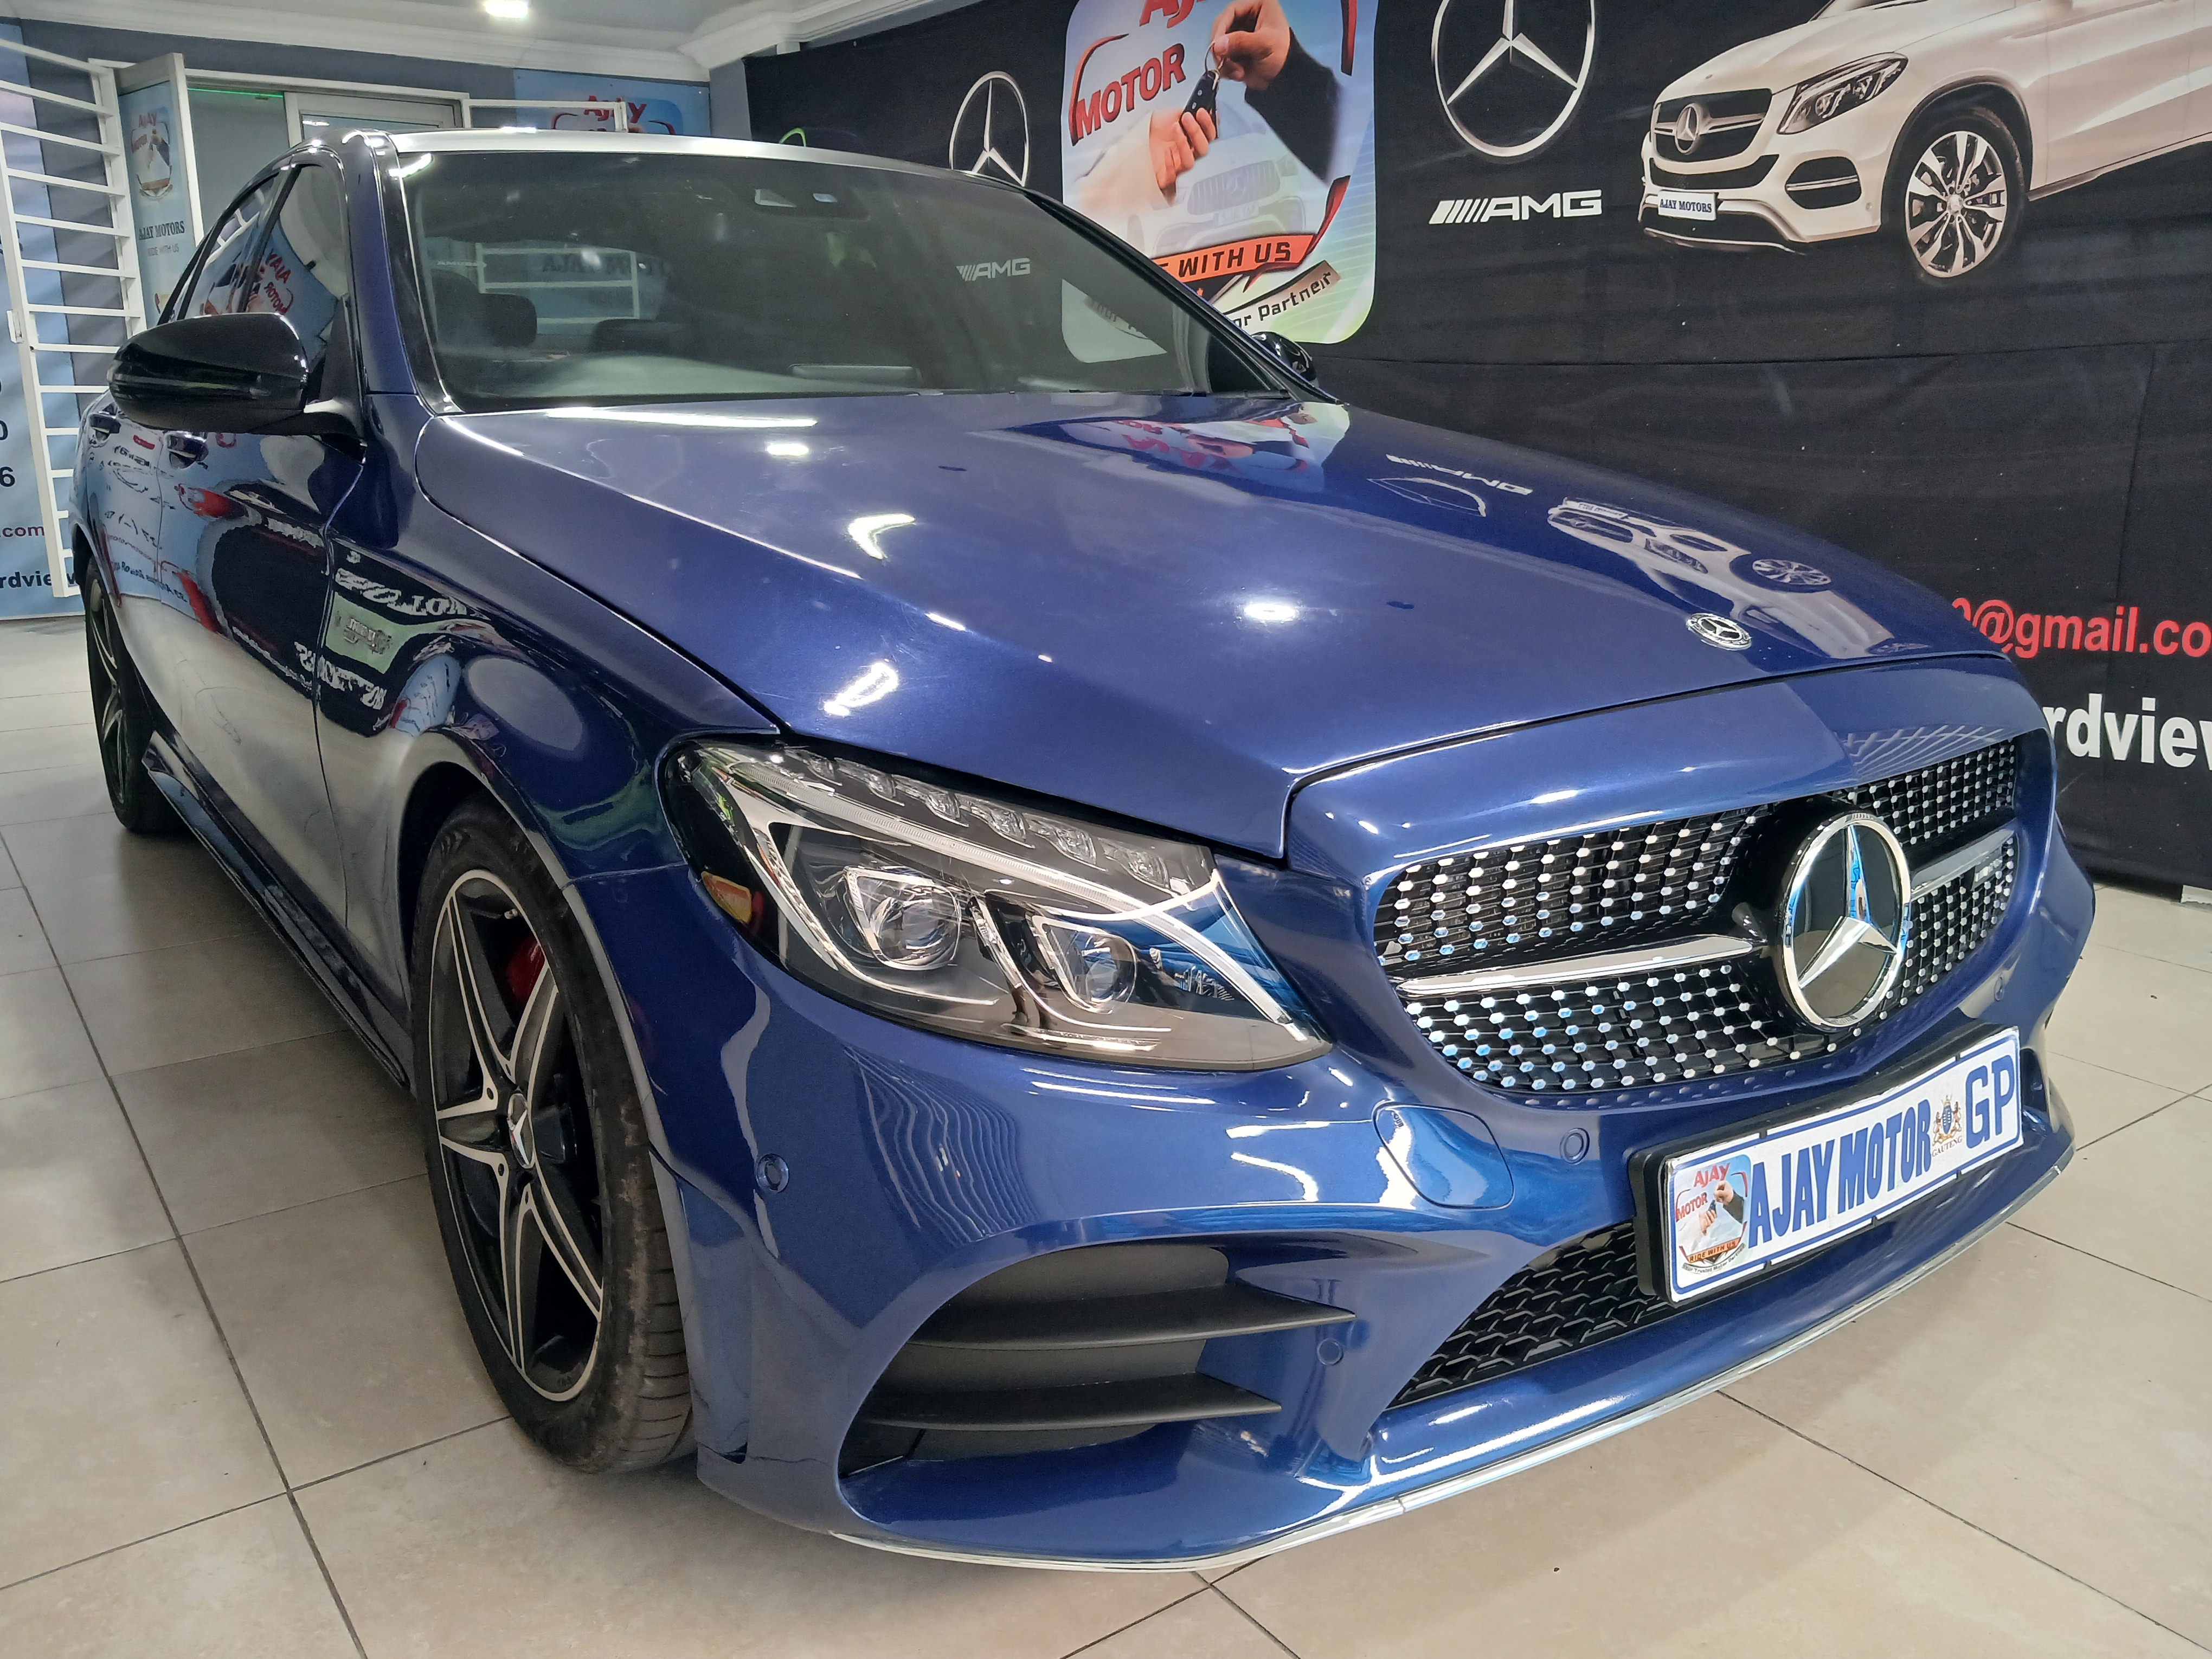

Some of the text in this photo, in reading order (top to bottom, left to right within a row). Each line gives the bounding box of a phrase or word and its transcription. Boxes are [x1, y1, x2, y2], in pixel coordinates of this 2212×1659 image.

[1075, 43, 1186, 138] MOTOR
[1660, 199, 1712, 213] AJAY MOTORS
[139, 221, 185, 240] AJAY MOTORS
[1178, 242, 1290, 277] WITH US
[1233, 272, 1332, 329] or Partner
[0, 467, 15, 487] 6
[1748, 1054, 2015, 1248] AJAY MOTOR GP
[1932, 1136, 1963, 1157] GAUTENG
[1694, 1162, 1731, 1188] AJAY
[1676, 1192, 1708, 1221] MOTOR
[1689, 1241, 1735, 1262] RIDE WITH US
[1713, 1262, 1727, 1271] Motor
